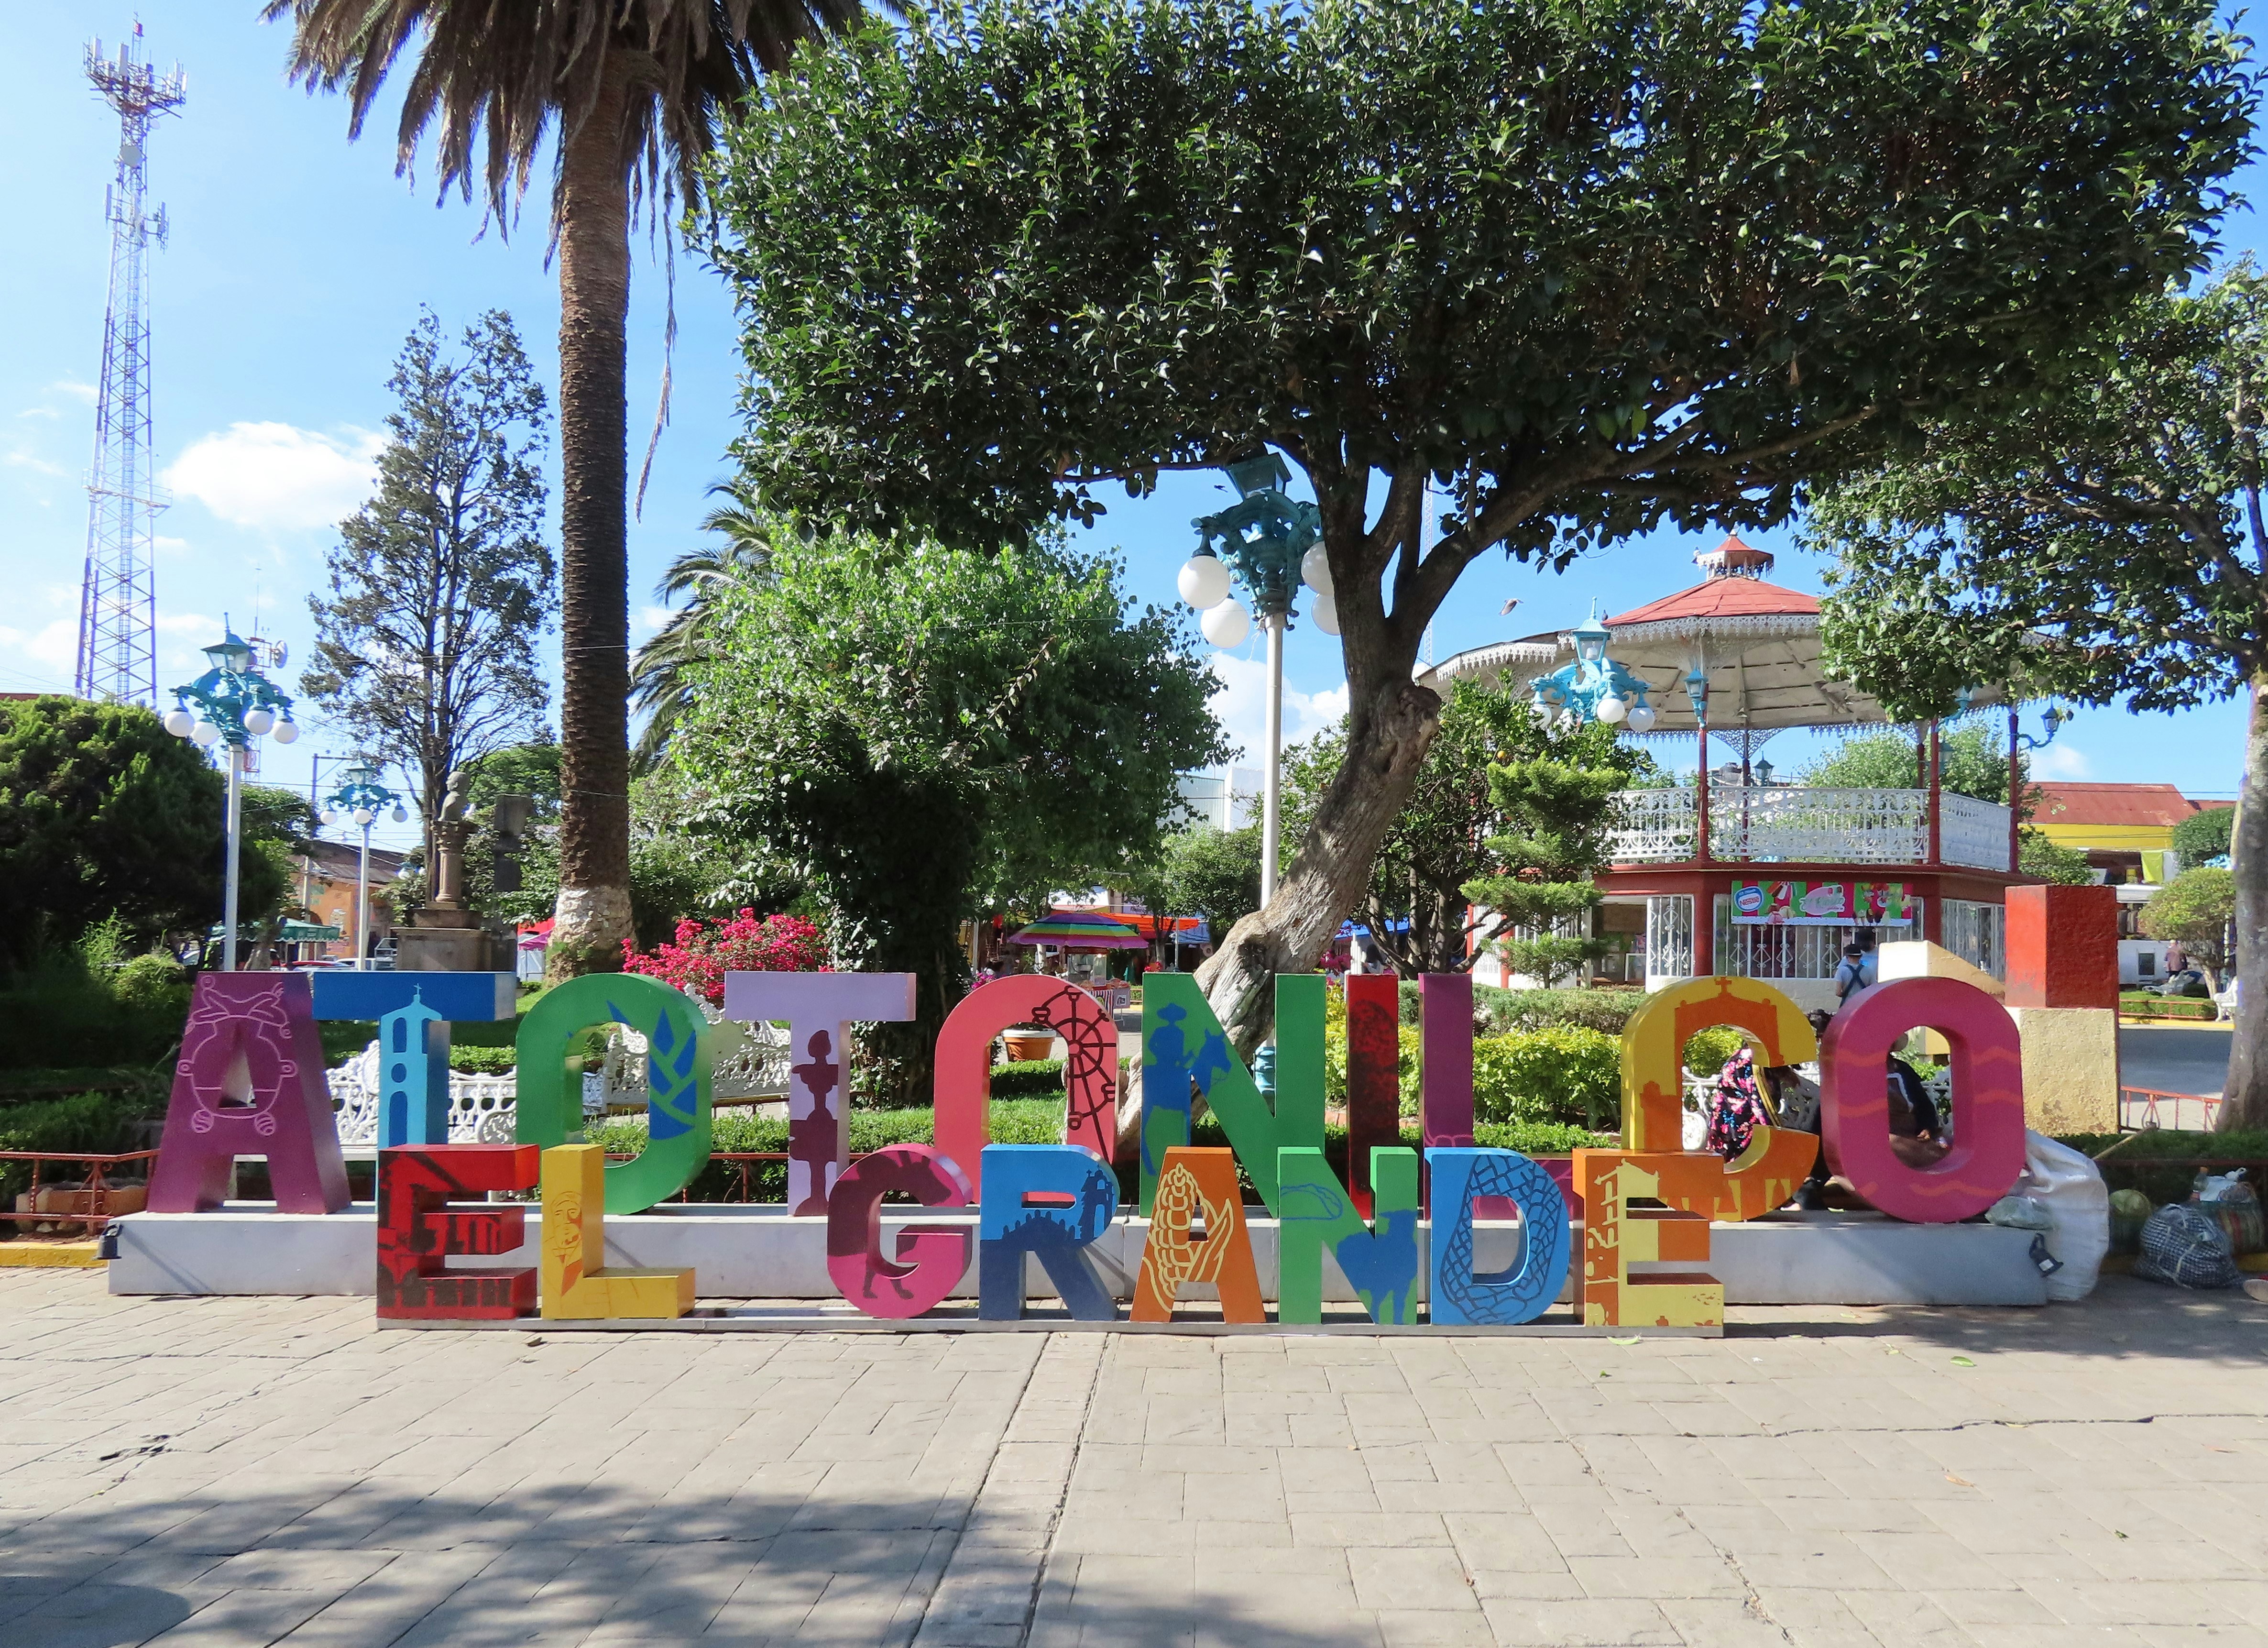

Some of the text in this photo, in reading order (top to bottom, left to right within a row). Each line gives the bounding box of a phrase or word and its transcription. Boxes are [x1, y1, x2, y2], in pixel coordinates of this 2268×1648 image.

[146, 971, 2027, 1223] ATOTONILCO
[378, 1143, 1724, 1327] EL GRANDE
